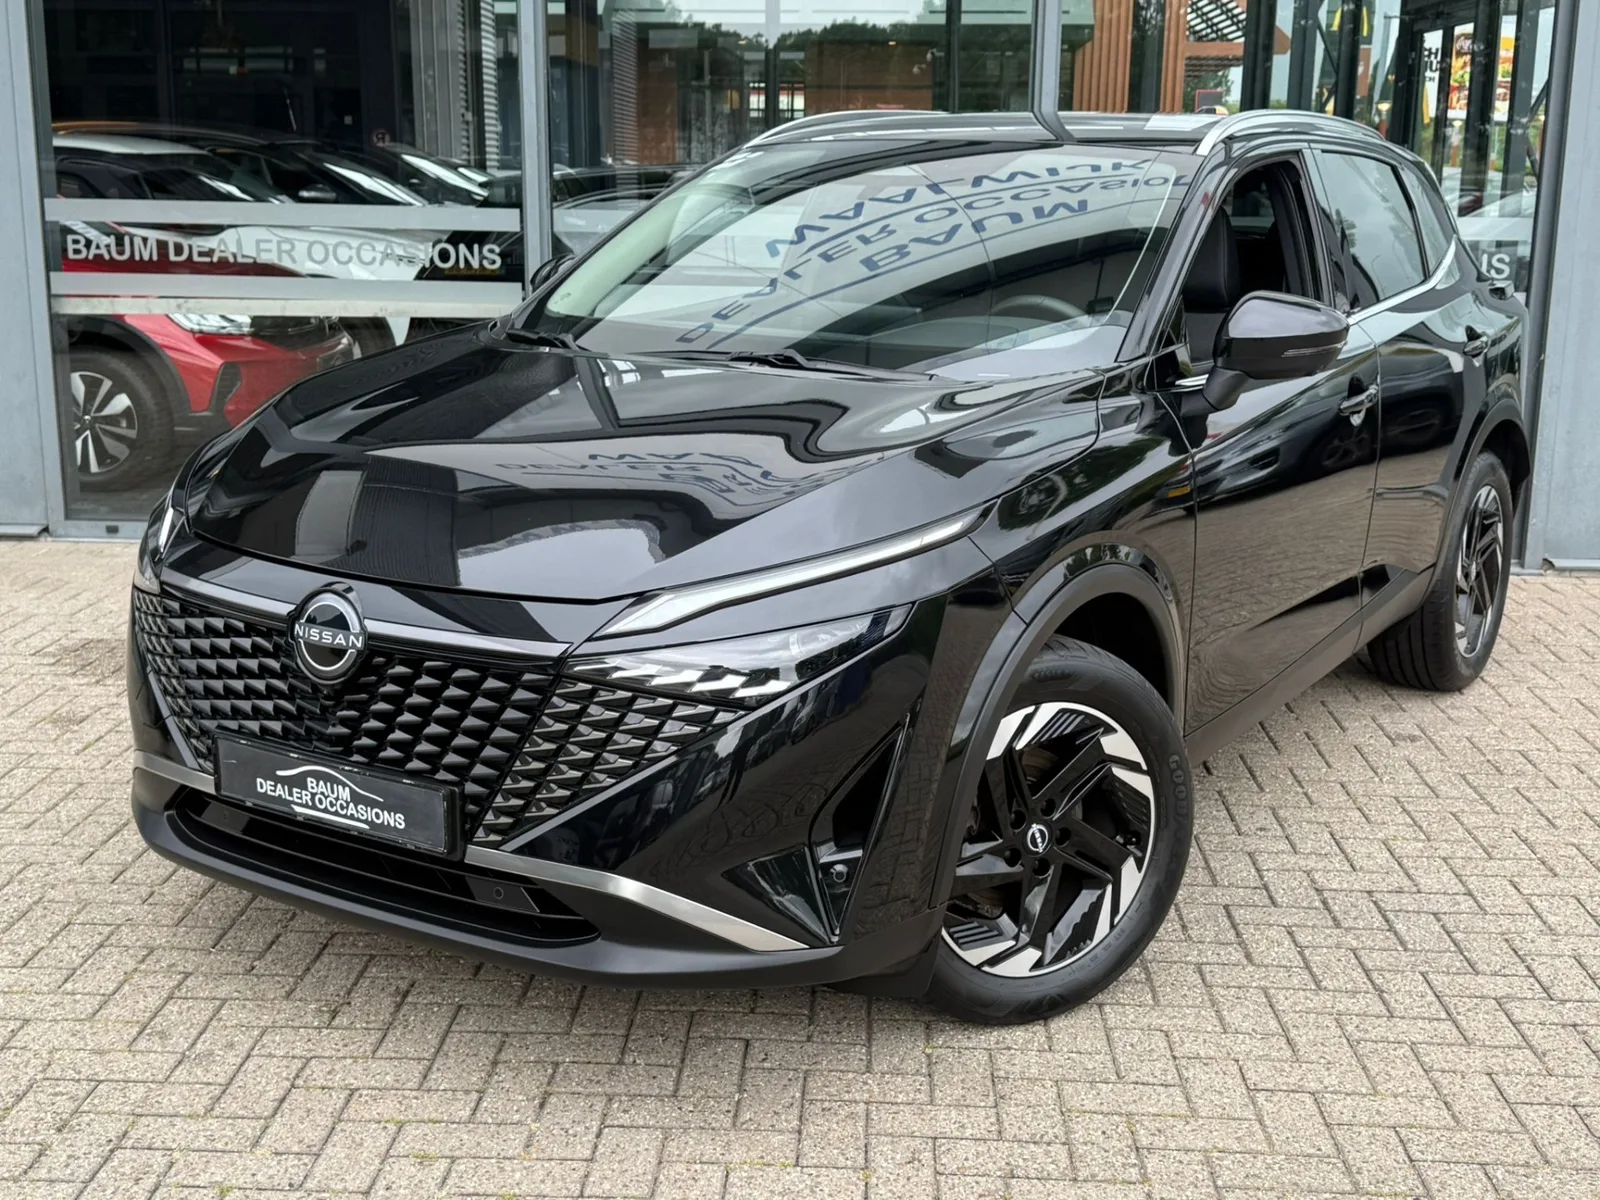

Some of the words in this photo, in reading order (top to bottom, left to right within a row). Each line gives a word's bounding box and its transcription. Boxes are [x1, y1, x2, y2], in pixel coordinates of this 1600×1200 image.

[66, 234, 157, 262] BAUM
[169, 237, 297, 265] DEALER
[307, 240, 502, 270] OCCASIONS
[294, 623, 363, 648] NISSAN
[256, 778, 312, 806] DEALER
[315, 796, 405, 829] OCCASIONS
[307, 777, 350, 801] BAUM
